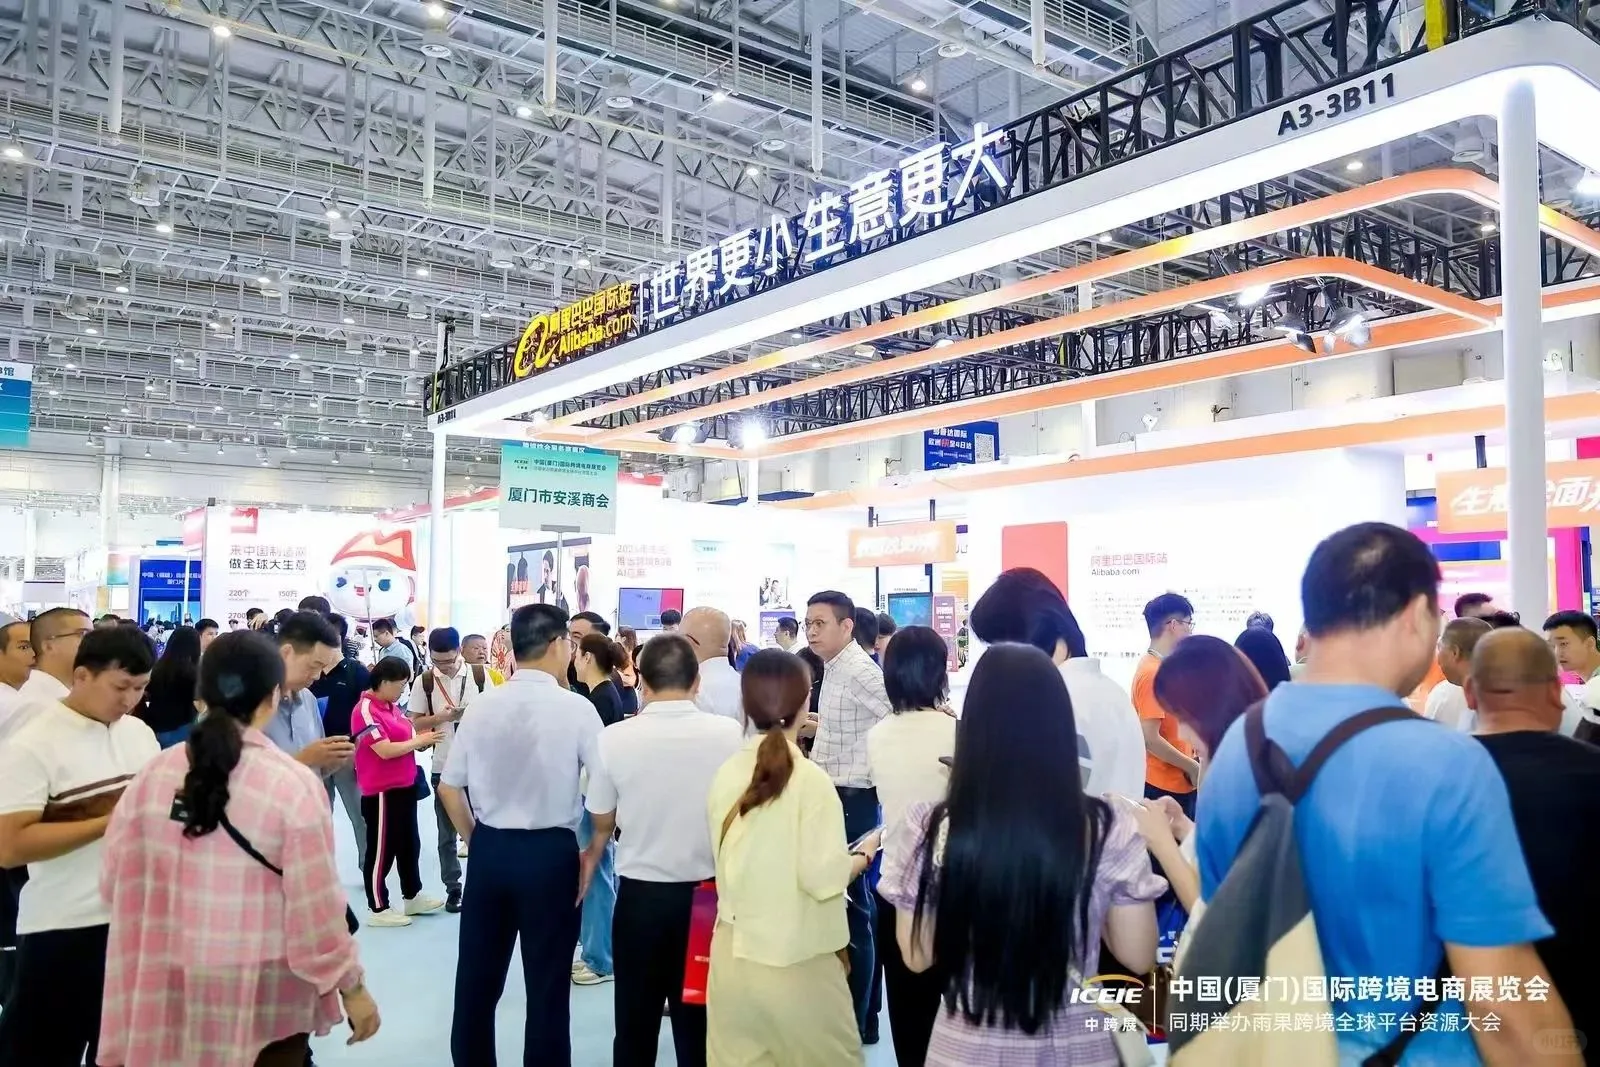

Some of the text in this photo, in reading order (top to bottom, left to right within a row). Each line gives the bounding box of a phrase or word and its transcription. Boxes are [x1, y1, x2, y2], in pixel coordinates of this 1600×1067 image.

[1278, 73, 1394, 135] A3-3B11
[560, 313, 632, 353] Alibaba.com
[508, 487, 609, 508] 厦门市安溪商会
[229, 558, 306, 570] 做全球大生意
